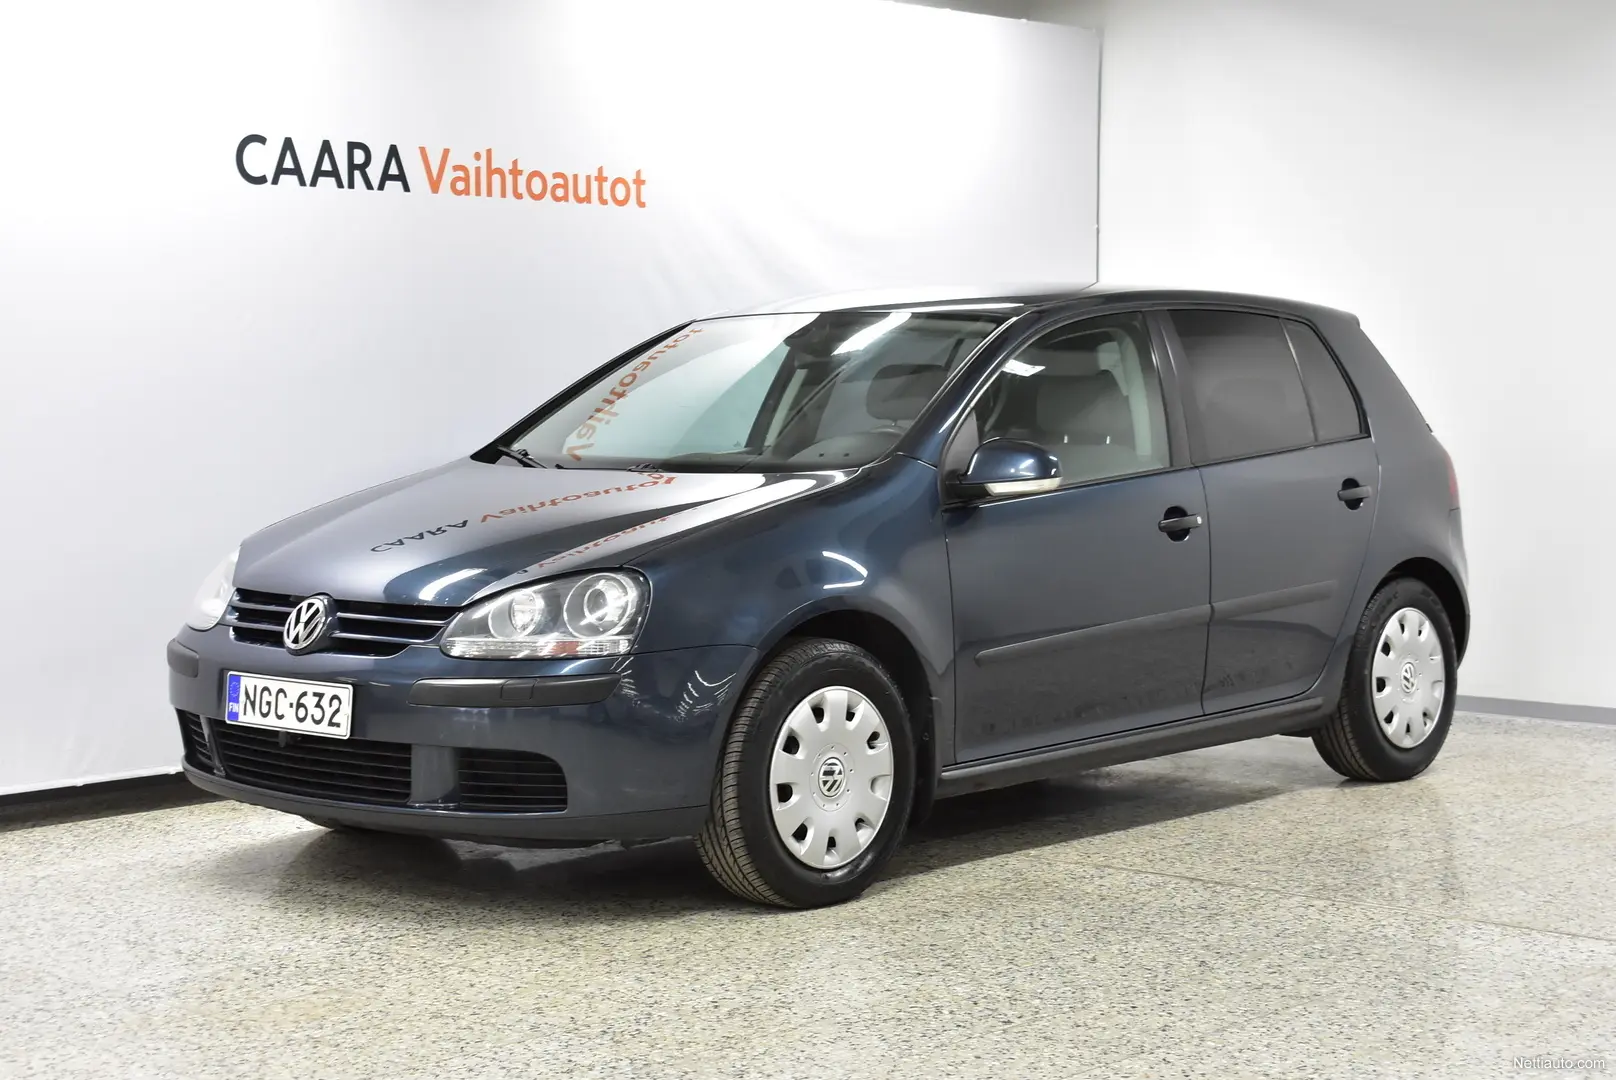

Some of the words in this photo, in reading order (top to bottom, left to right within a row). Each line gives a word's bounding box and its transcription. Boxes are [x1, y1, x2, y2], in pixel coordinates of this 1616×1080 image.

[235, 134, 410, 192] CAARA
[418, 146, 647, 208] Vaihtoautot
[228, 702, 239, 713] FIN
